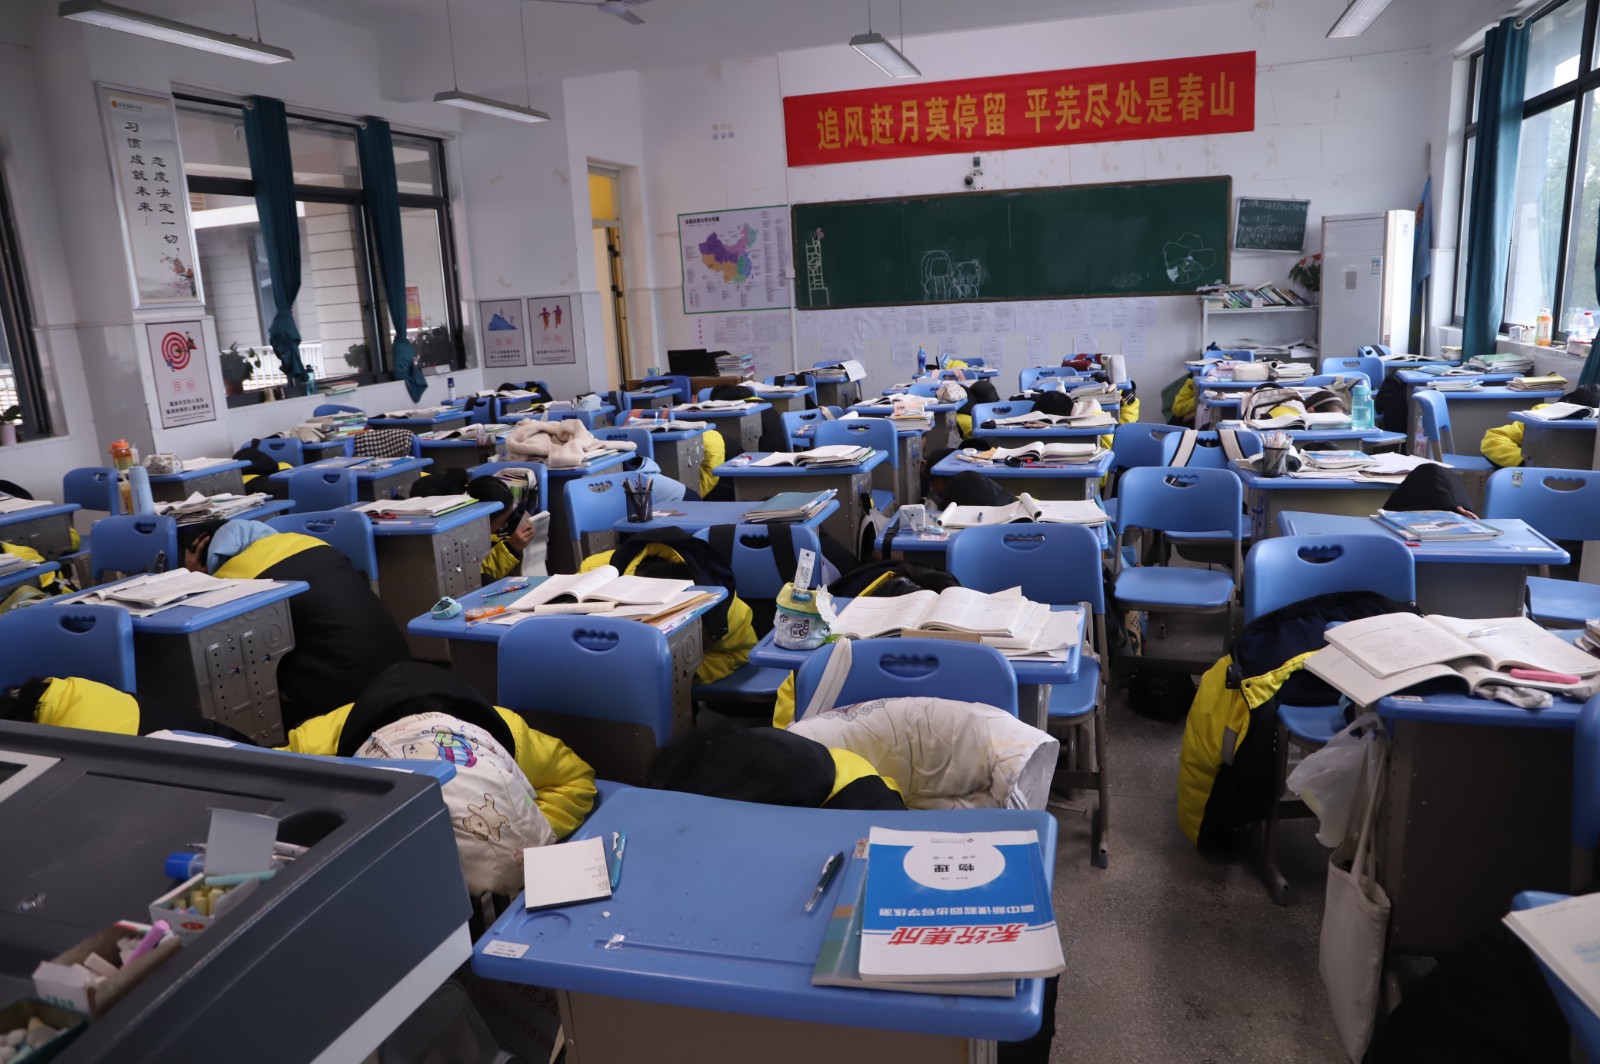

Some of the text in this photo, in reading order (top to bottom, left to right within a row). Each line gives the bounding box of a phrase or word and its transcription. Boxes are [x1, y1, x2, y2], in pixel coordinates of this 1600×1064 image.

[816, 71, 1235, 150] 追风赶月莫停留 平芜尽处是春山
[934, 863, 975, 873] 物理
[879, 904, 1035, 917] 高中新课程同步导学练测
[887, 924, 1026, 946] 系统集成
